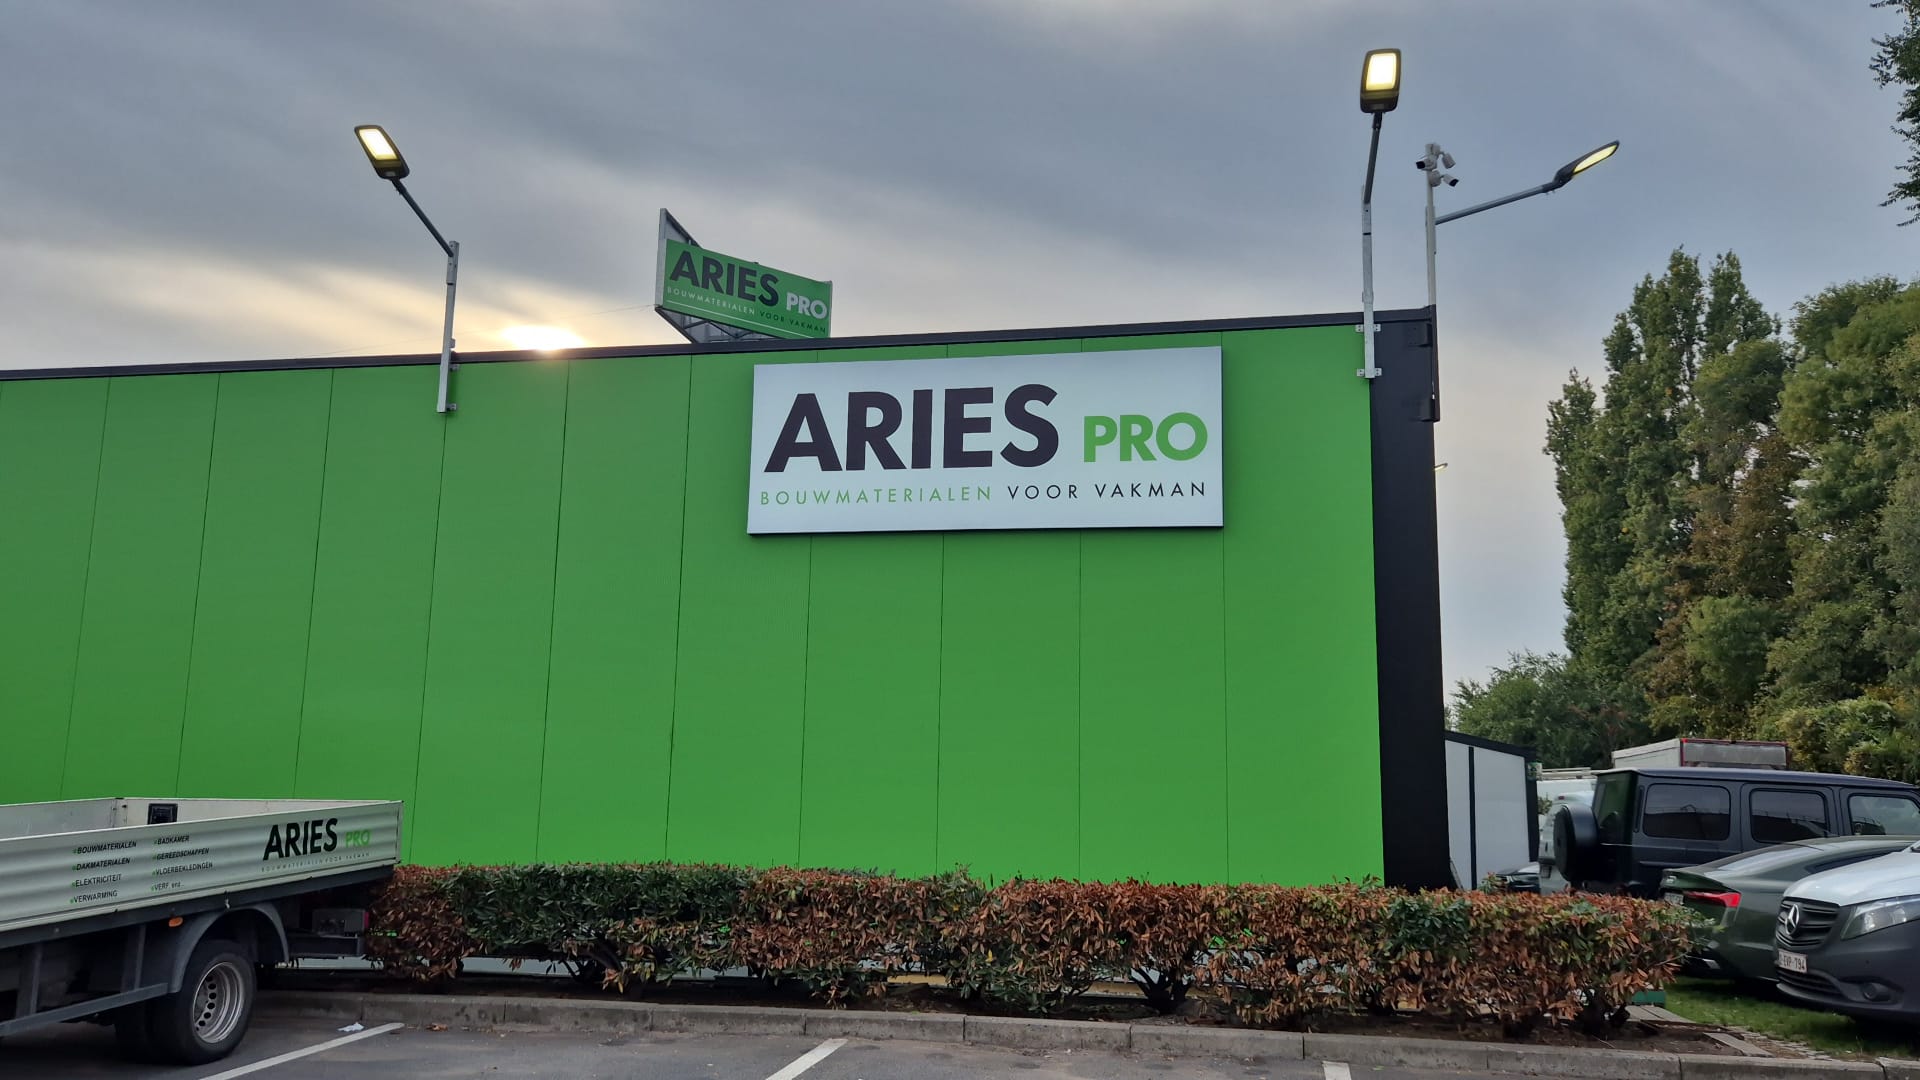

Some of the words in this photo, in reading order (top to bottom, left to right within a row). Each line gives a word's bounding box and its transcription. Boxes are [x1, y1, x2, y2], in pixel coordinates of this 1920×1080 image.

[669, 250, 779, 307] ARIES
[786, 292, 828, 320] PRO
[667, 286, 755, 316] BOUWMATERIALEN
[759, 310, 785, 323] VOOR
[789, 319, 826, 335] VAKMAN
[763, 383, 1060, 473] ARIES
[1083, 411, 1208, 463] PRO
[760, 485, 991, 506] BOUWMATERIALEN
[1007, 483, 1078, 500] VOOR
[1094, 481, 1206, 498] VAKMAN
[157, 835, 190, 846] BADKAMER
[262, 817, 339, 861] ARIES
[345, 829, 371, 848] PRO
[77, 841, 137, 855] BOUWMATERIALEN
[156, 847, 210, 861] GEREEDSCHAPPEN
[76, 857, 131, 871] DAKMATERIALEN
[155, 862, 213, 876] VLOERBEKLEDINGEN
[75, 873, 122, 888] ELEKTRICITEIT
[73, 890, 118, 904] VERWARMING
